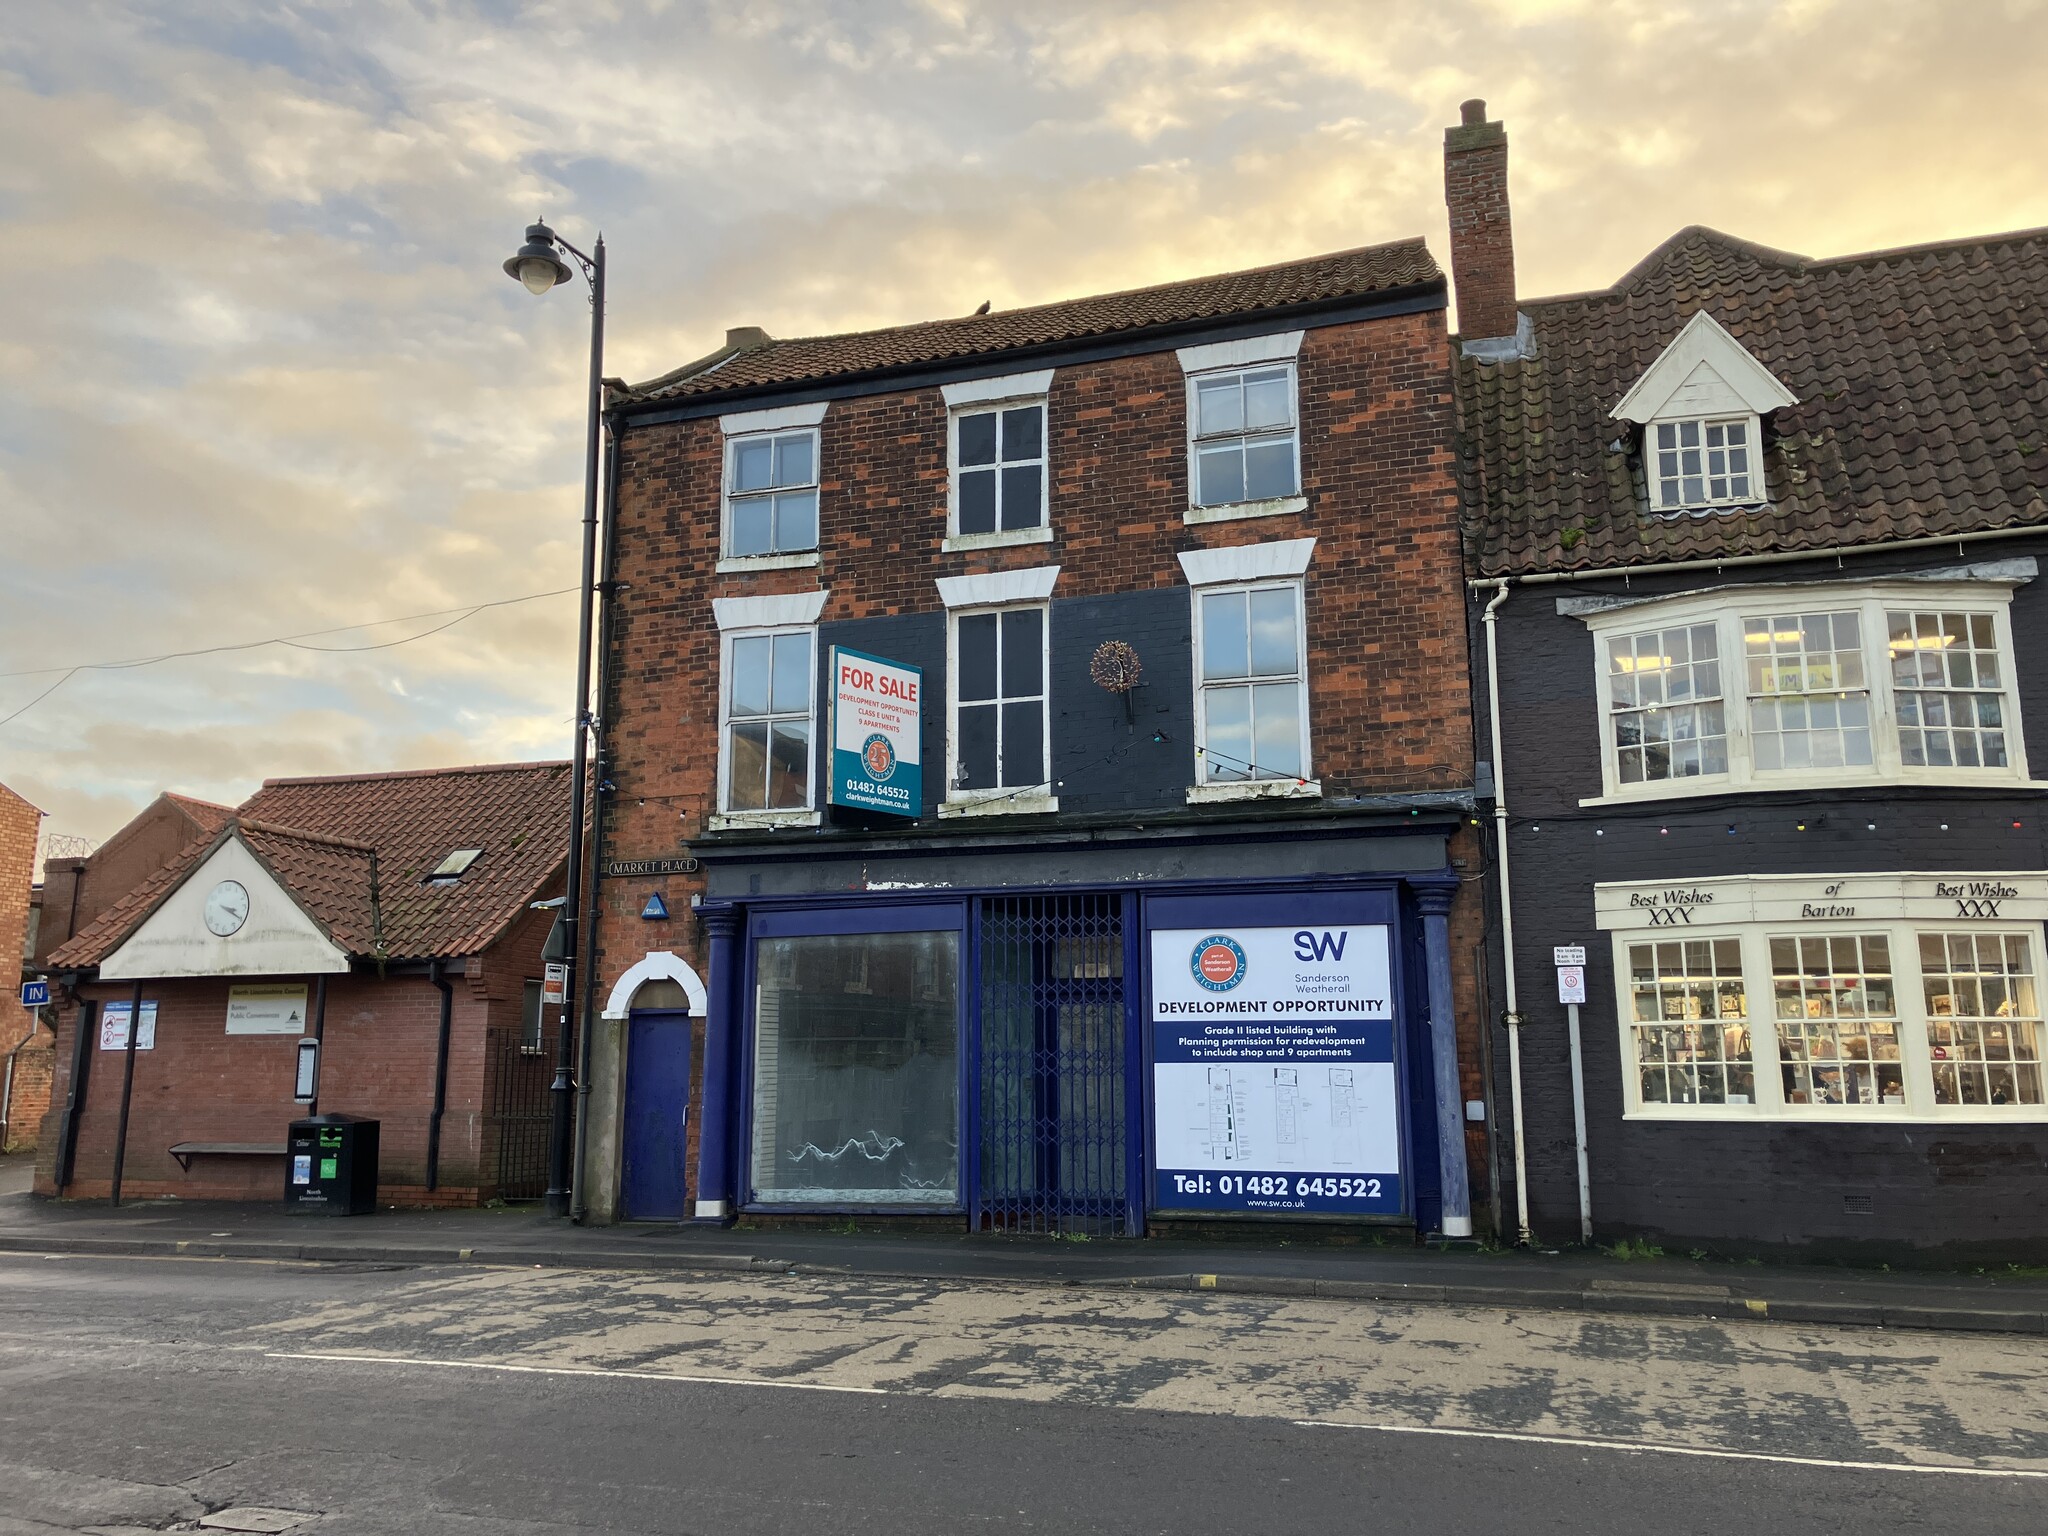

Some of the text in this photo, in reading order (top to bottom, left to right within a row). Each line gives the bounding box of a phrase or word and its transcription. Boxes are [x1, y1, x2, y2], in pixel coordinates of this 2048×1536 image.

[842, 666, 916, 702] FOR SALE
[839, 693, 918, 717] DEVELOPMENT OPPORTUNITY
[858, 708, 875, 718] CLASS
[882, 713, 895, 722] UNIT
[864, 720, 899, 733] APARTMENTS
[868, 736, 889, 746] CLARK
[870, 746, 886, 769] 25
[863, 754, 894, 778] WEIGHTMAN
[846, 780, 909, 799] 01482 645522
[846, 792, 910, 810] clarkweightman.co.uk
[614, 859, 692, 874] MARKET PLACE
[1825, 882, 1845, 897] of
[1936, 882, 2018, 898] Best Wishes
[1630, 889, 1714, 906] Best Wishes
[1802, 903, 1855, 918] Barton
[1956, 900, 2001, 918] XXX
[1200, 937, 1236, 949] CLARK
[1294, 931, 1348, 961] SW
[1192, 963, 1245, 990] WEIGHTMAN
[1295, 973, 1350, 982] Sanderson
[29, 987, 43, 1000] IN
[1295, 984, 1350, 993] Weatherall
[1159, 1000, 1384, 1013] DEVELOPMENT OPPORTUNITY
[1204, 1026, 1234, 1034] Grade
[1246, 1026, 1271, 1034] listed
[1274, 1026, 1313, 1035] building
[1316, 1025, 1337, 1034] with
[1178, 1036, 1366, 1047] Planning permission for redevelopment
[1204, 1048, 1238, 1056] include
[1240, 1048, 1264, 1058] shop
[1266, 1048, 1284, 1056] and
[1296, 1048, 1352, 1057] apartments
[1173, 1175, 1381, 1198] Tel: 01482 645522
[1247, 1199, 1305, 1208] www.sw.co.uk
